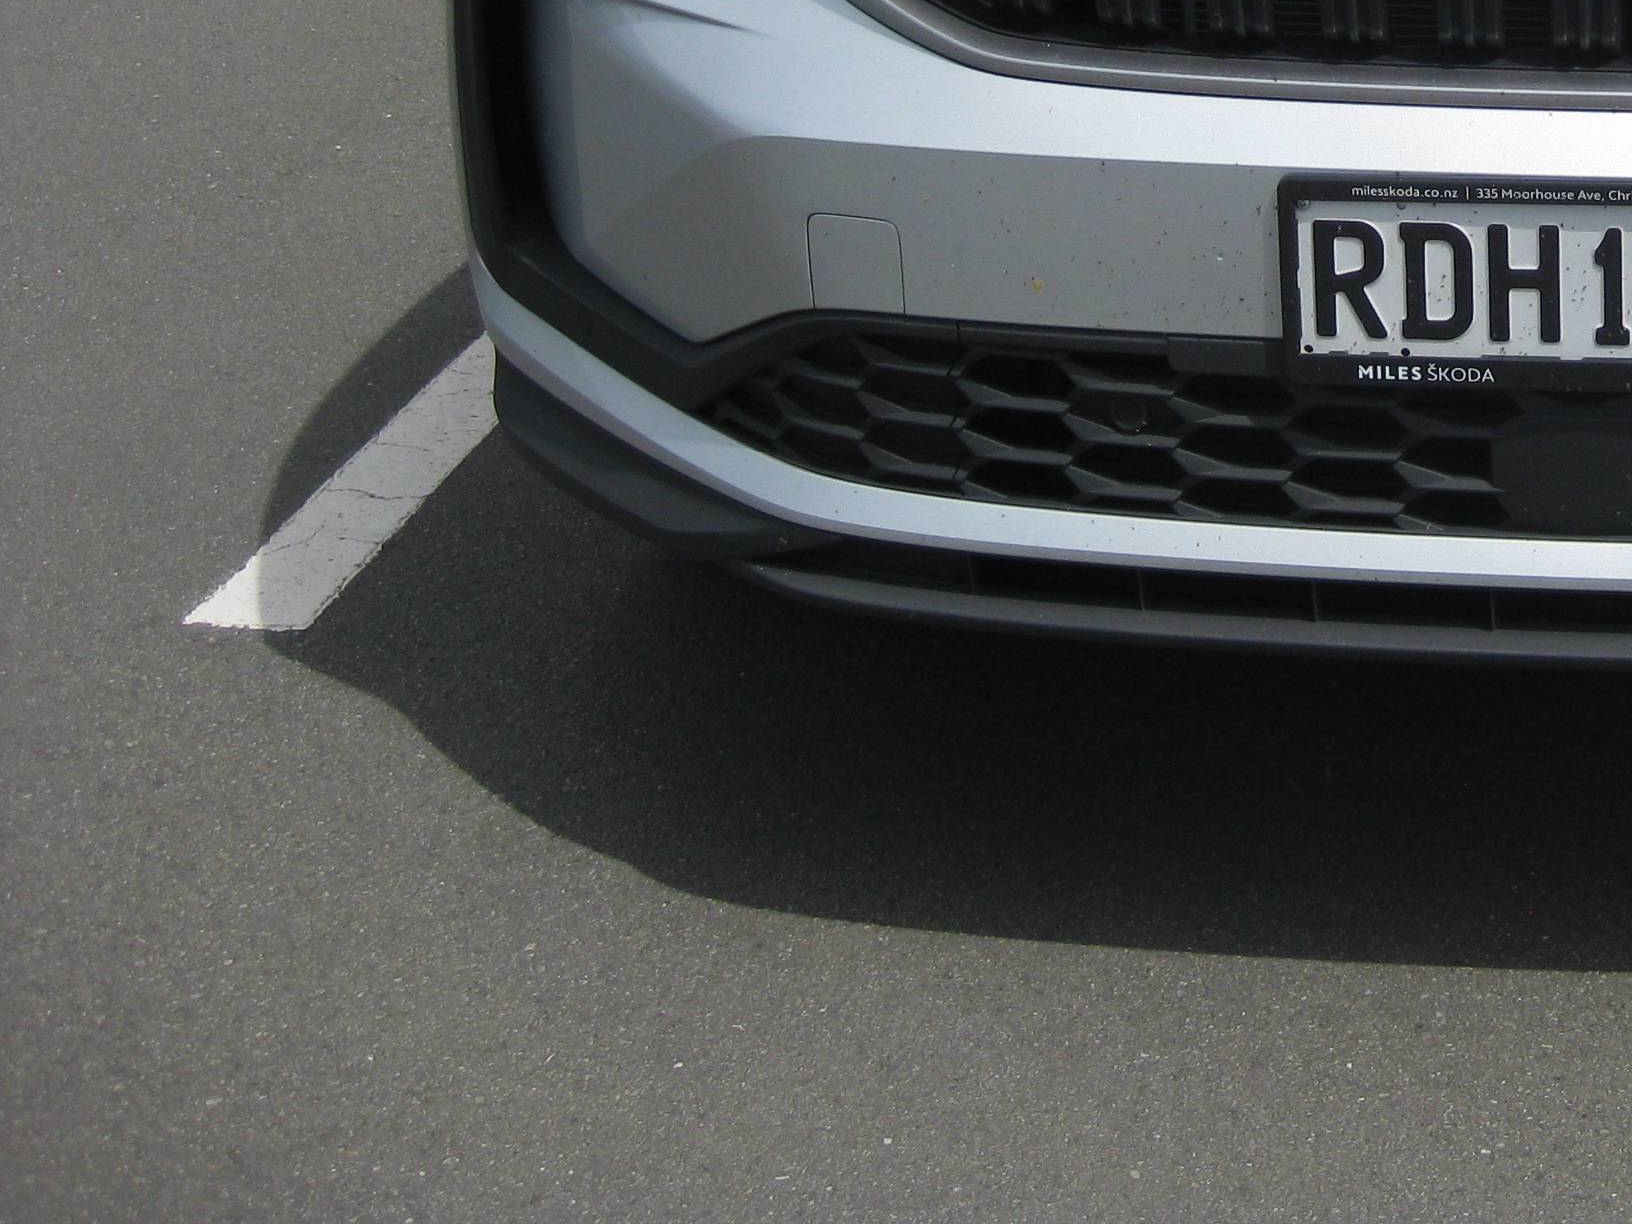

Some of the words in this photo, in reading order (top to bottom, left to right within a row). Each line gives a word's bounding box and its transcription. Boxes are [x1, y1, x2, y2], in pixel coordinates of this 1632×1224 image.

[1351, 185, 1459, 198] milesskoda.co.nz
[1476, 187, 1498, 199] 335
[1501, 188, 1575, 200] Moorhouse
[1358, 364, 1422, 381] MILES
[1427, 362, 1495, 383] ŠKODA
